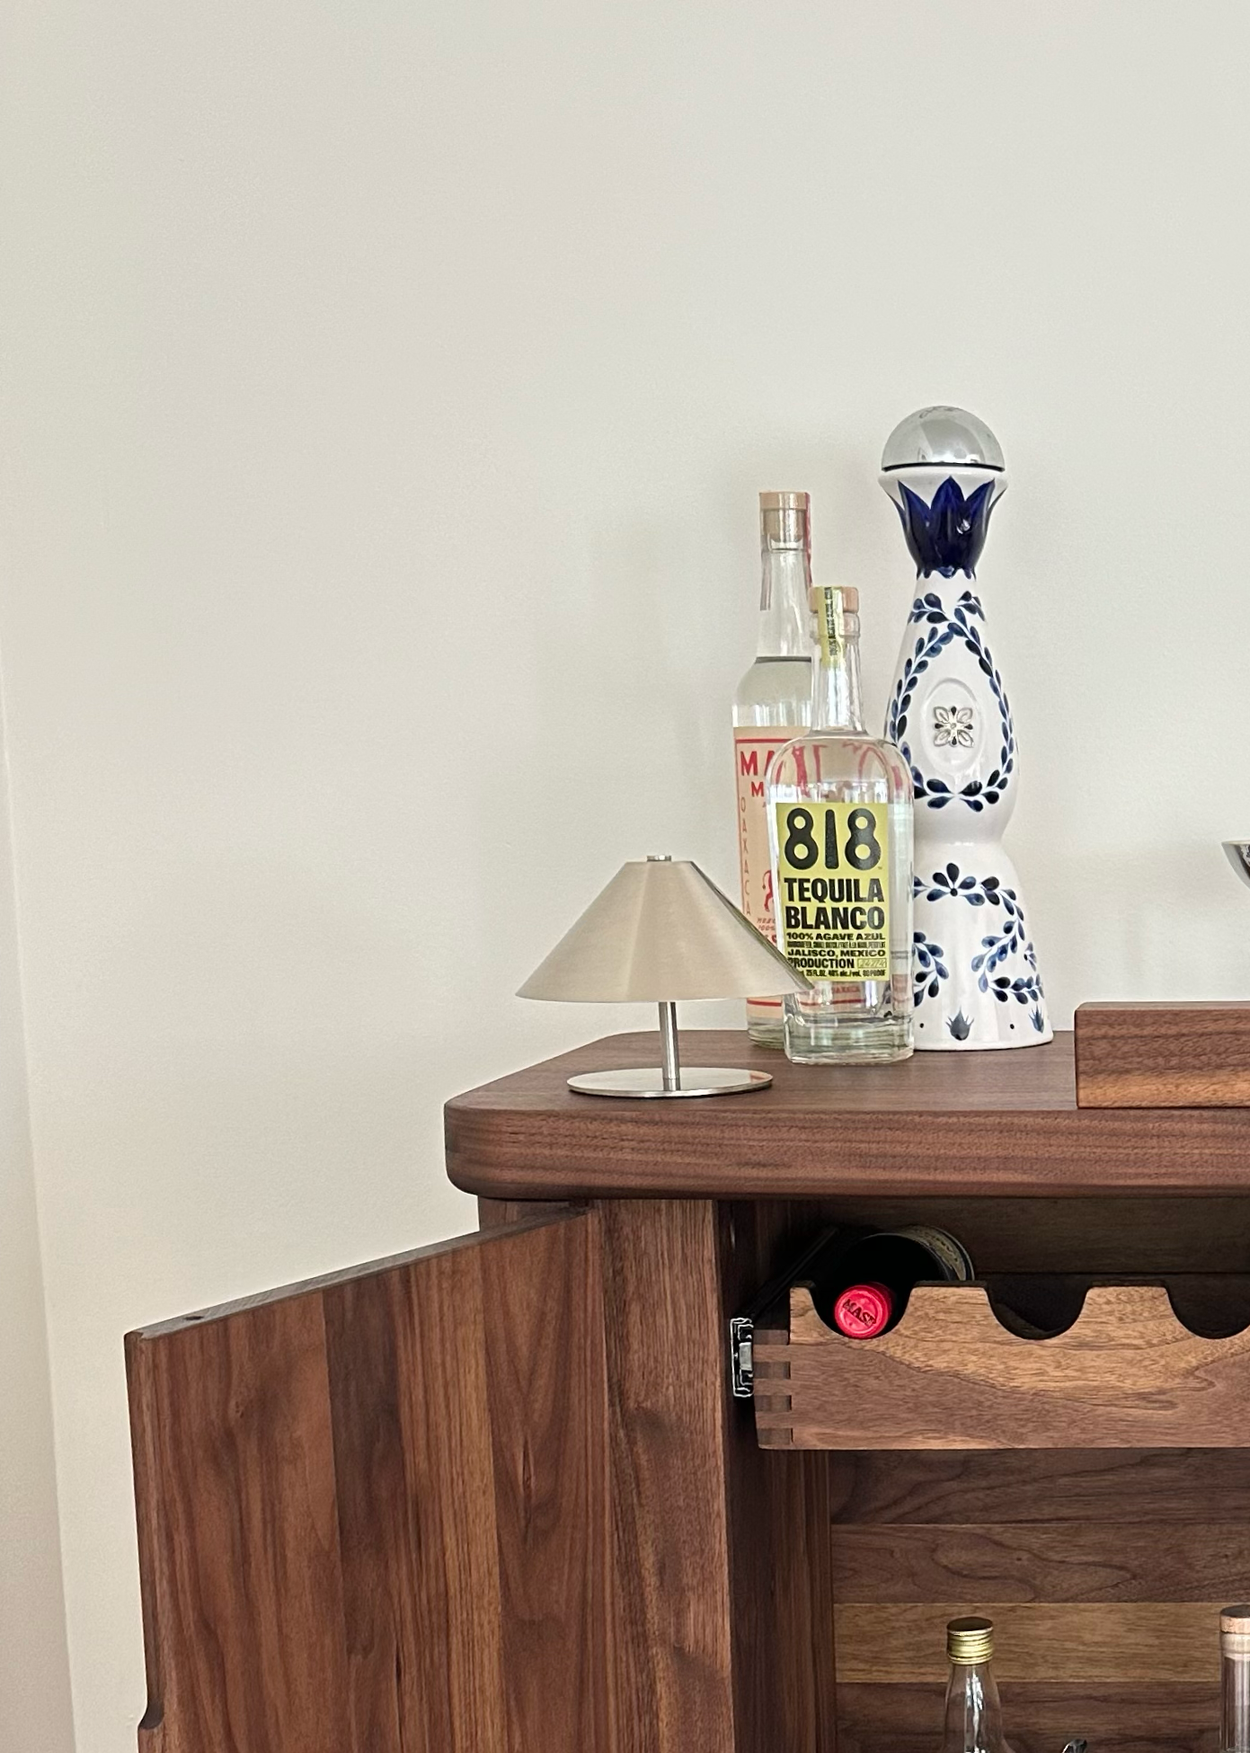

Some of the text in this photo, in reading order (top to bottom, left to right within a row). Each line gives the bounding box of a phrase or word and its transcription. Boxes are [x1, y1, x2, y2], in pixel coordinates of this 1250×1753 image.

[785, 807, 881, 871] 818
[740, 796, 751, 916] OAXACA
[784, 878, 885, 903] TEQUILA
[785, 906, 885, 930] BLANCO
[786, 932, 886, 941] 100% AGAVE AZUL
[788, 949, 886, 958] JALISCO, MEXICO
[788, 957, 855, 969] PRODUCTION
